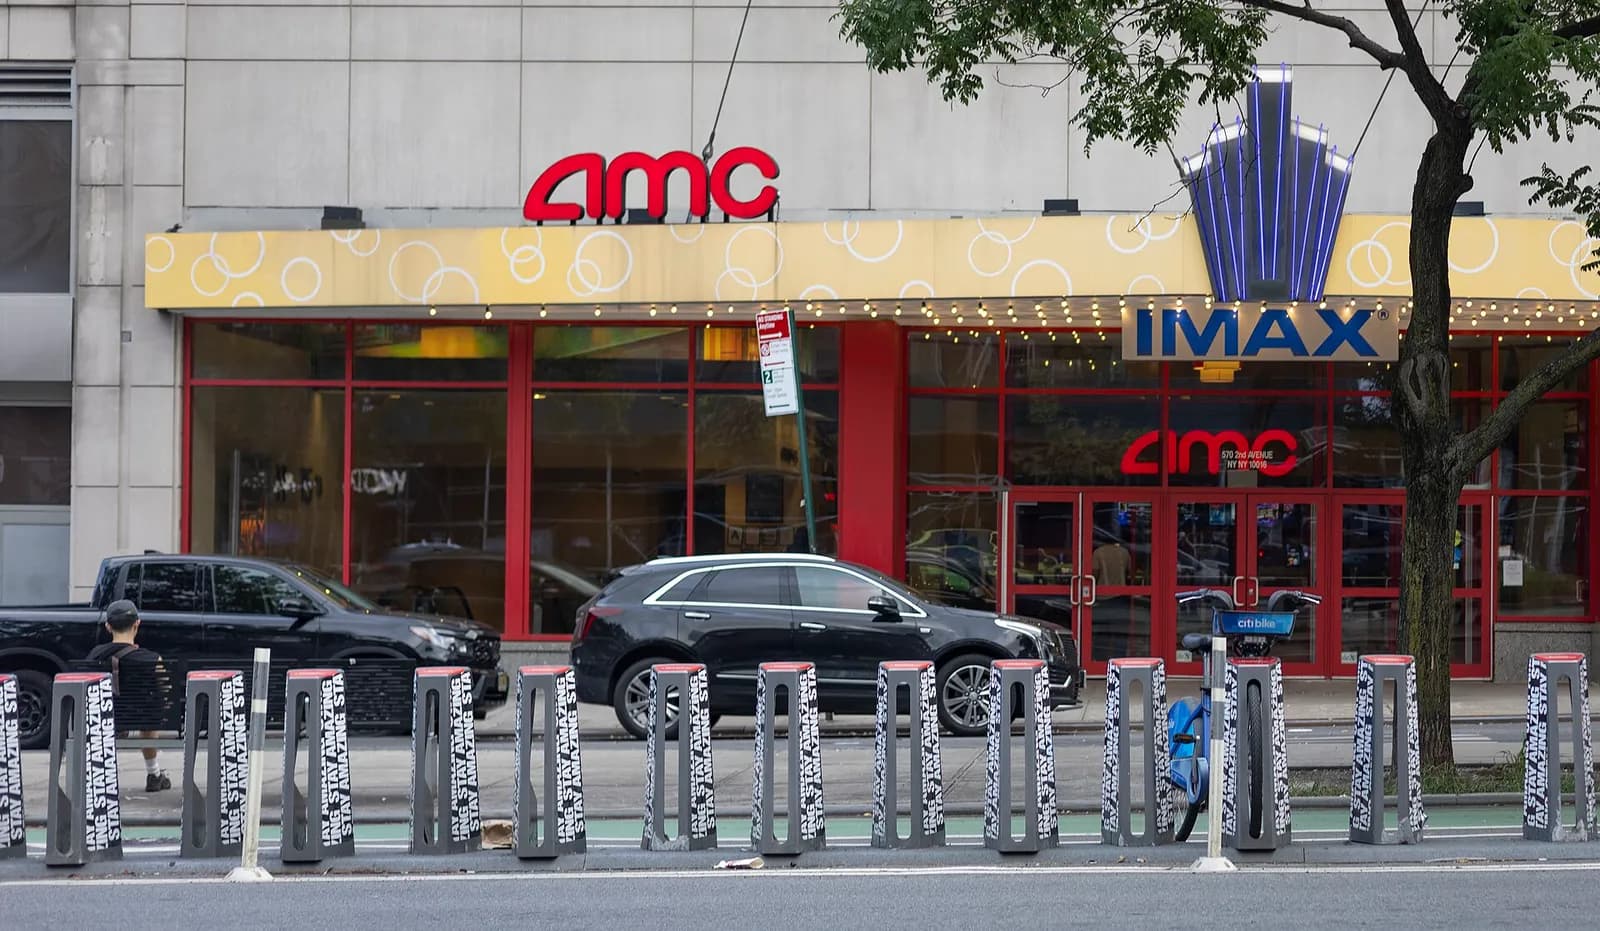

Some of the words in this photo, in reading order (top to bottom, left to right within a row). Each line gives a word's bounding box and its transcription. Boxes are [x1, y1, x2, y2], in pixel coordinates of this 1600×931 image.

[1137, 309, 1379, 357] IMAX
[764, 371, 771, 383] 2
[1221, 450, 1234, 459] 570
[1234, 450, 1247, 459] 2nd
[1247, 450, 1273, 459] AVENUE
[1227, 460, 1237, 469] NY
[1238, 460, 1247, 469] NY
[1238, 618, 1254, 629] citi
[1255, 618, 1276, 629] bike
[5, 680, 17, 712] STA
[100, 680, 113, 712] STA
[232, 674, 244, 708] STA
[332, 673, 344, 707] STA
[461, 671, 472, 704] STA
[565, 671, 576, 704] STA
[698, 669, 708, 702] STA
[88, 686, 104, 763] AMAZING
[222, 681, 237, 757] AMAZING
[322, 680, 338, 757] AMAZING
[451, 678, 467, 755] AMAZING
[557, 677, 570, 754] AMAZING
[690, 675, 703, 753] AMAZING
[1356, 689, 1367, 765] AMAZING
[1529, 686, 1539, 763] AMAZING
[6, 720, 21, 795] AMAZING
[102, 718, 118, 794] AMAZING
[235, 714, 248, 788] AMAZING
[336, 713, 350, 789] AMAZING
[463, 710, 478, 788] AMAZING
[568, 710, 582, 788] AMAZING
[700, 708, 713, 787] AMAZING
[1362, 724, 1372, 798] AMAZING
[1537, 722, 1547, 798] AMAZING
[93, 768, 106, 808] STAY
[227, 762, 239, 803] STAY
[327, 762, 340, 803] STAY
[457, 759, 469, 800] STAY
[563, 759, 573, 799] STAY
[695, 757, 705, 796] STAY
[1354, 768, 1362, 809] STAY
[1528, 765, 1536, 807] STAY
[10, 799, 23, 839] STAY
[108, 800, 121, 841] STAY
[340, 795, 352, 836] STAY
[469, 791, 480, 832] STAY
[573, 792, 584, 833] STAY
[705, 790, 715, 829] STAY
